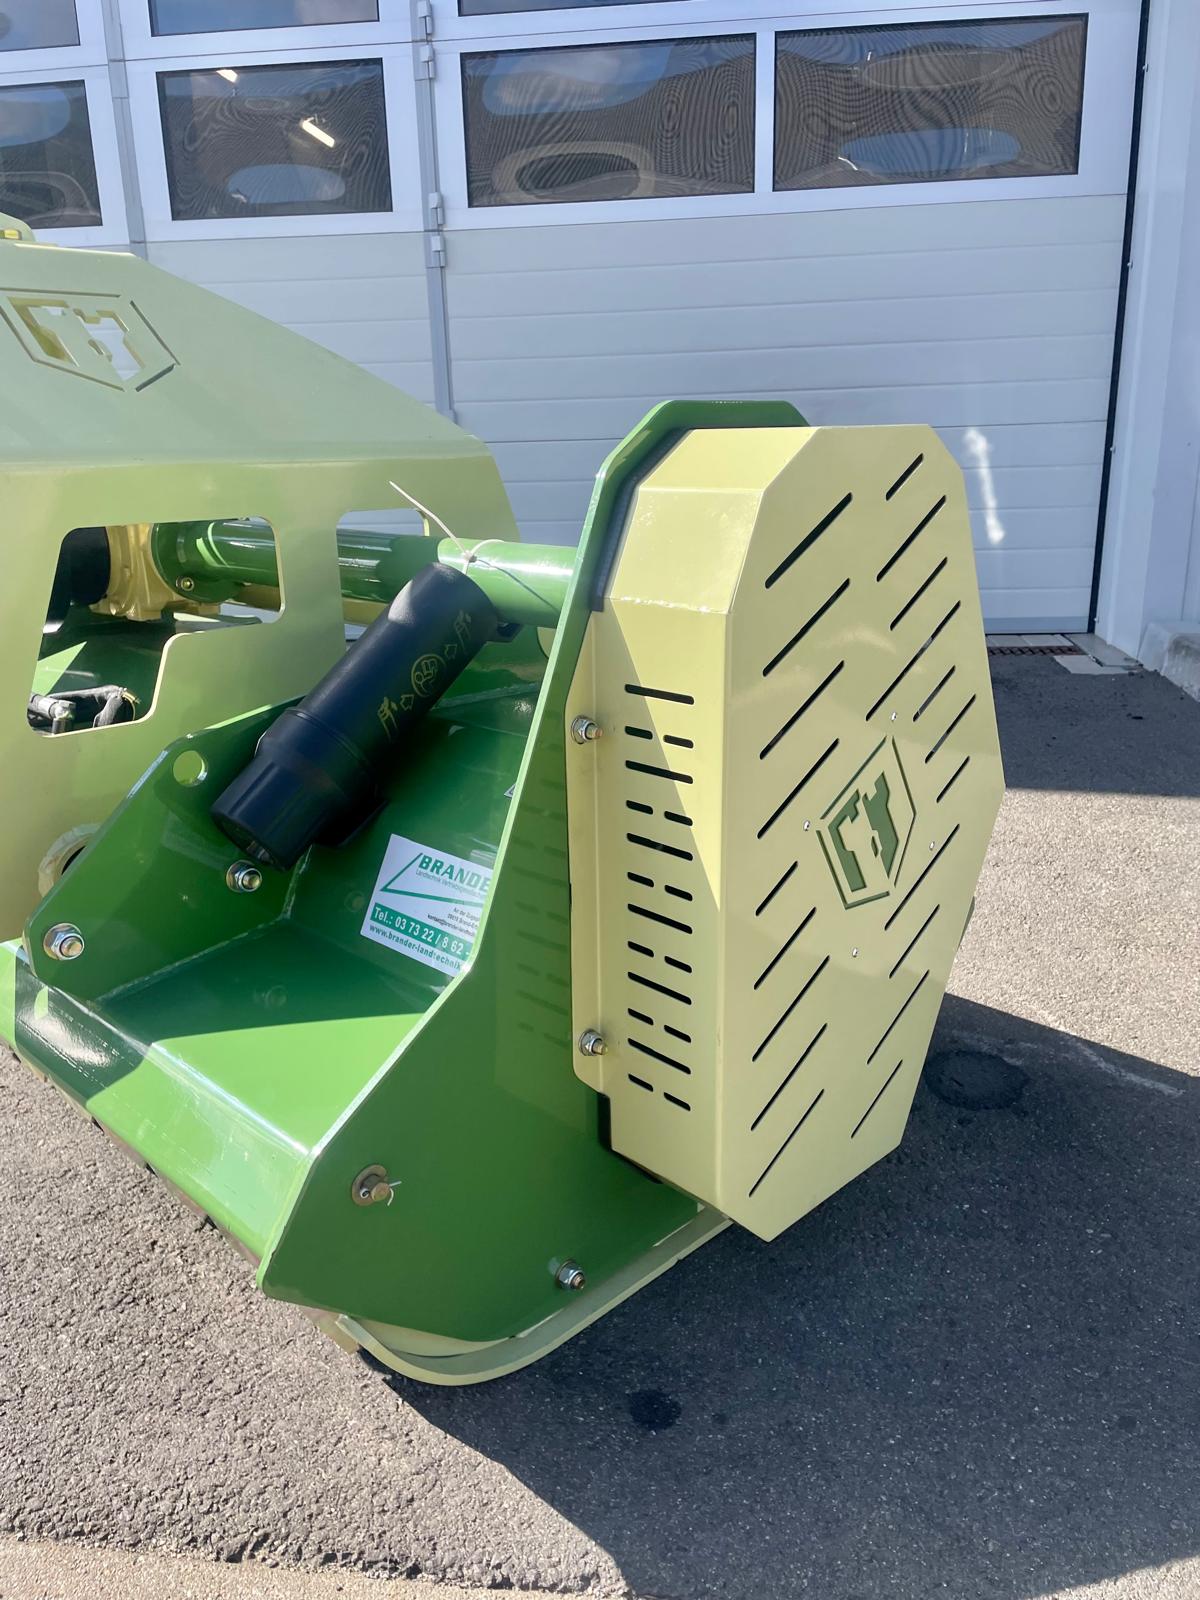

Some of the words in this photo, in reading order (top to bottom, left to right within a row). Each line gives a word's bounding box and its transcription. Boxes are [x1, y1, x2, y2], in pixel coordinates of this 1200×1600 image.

[374, 907, 392, 924] Tel.:
[395, 916, 406, 930] 03
[408, 922, 421, 936] 73
[421, 928, 435, 942] 22
[442, 936, 449, 948] 8
[451, 940, 464, 955] 62
